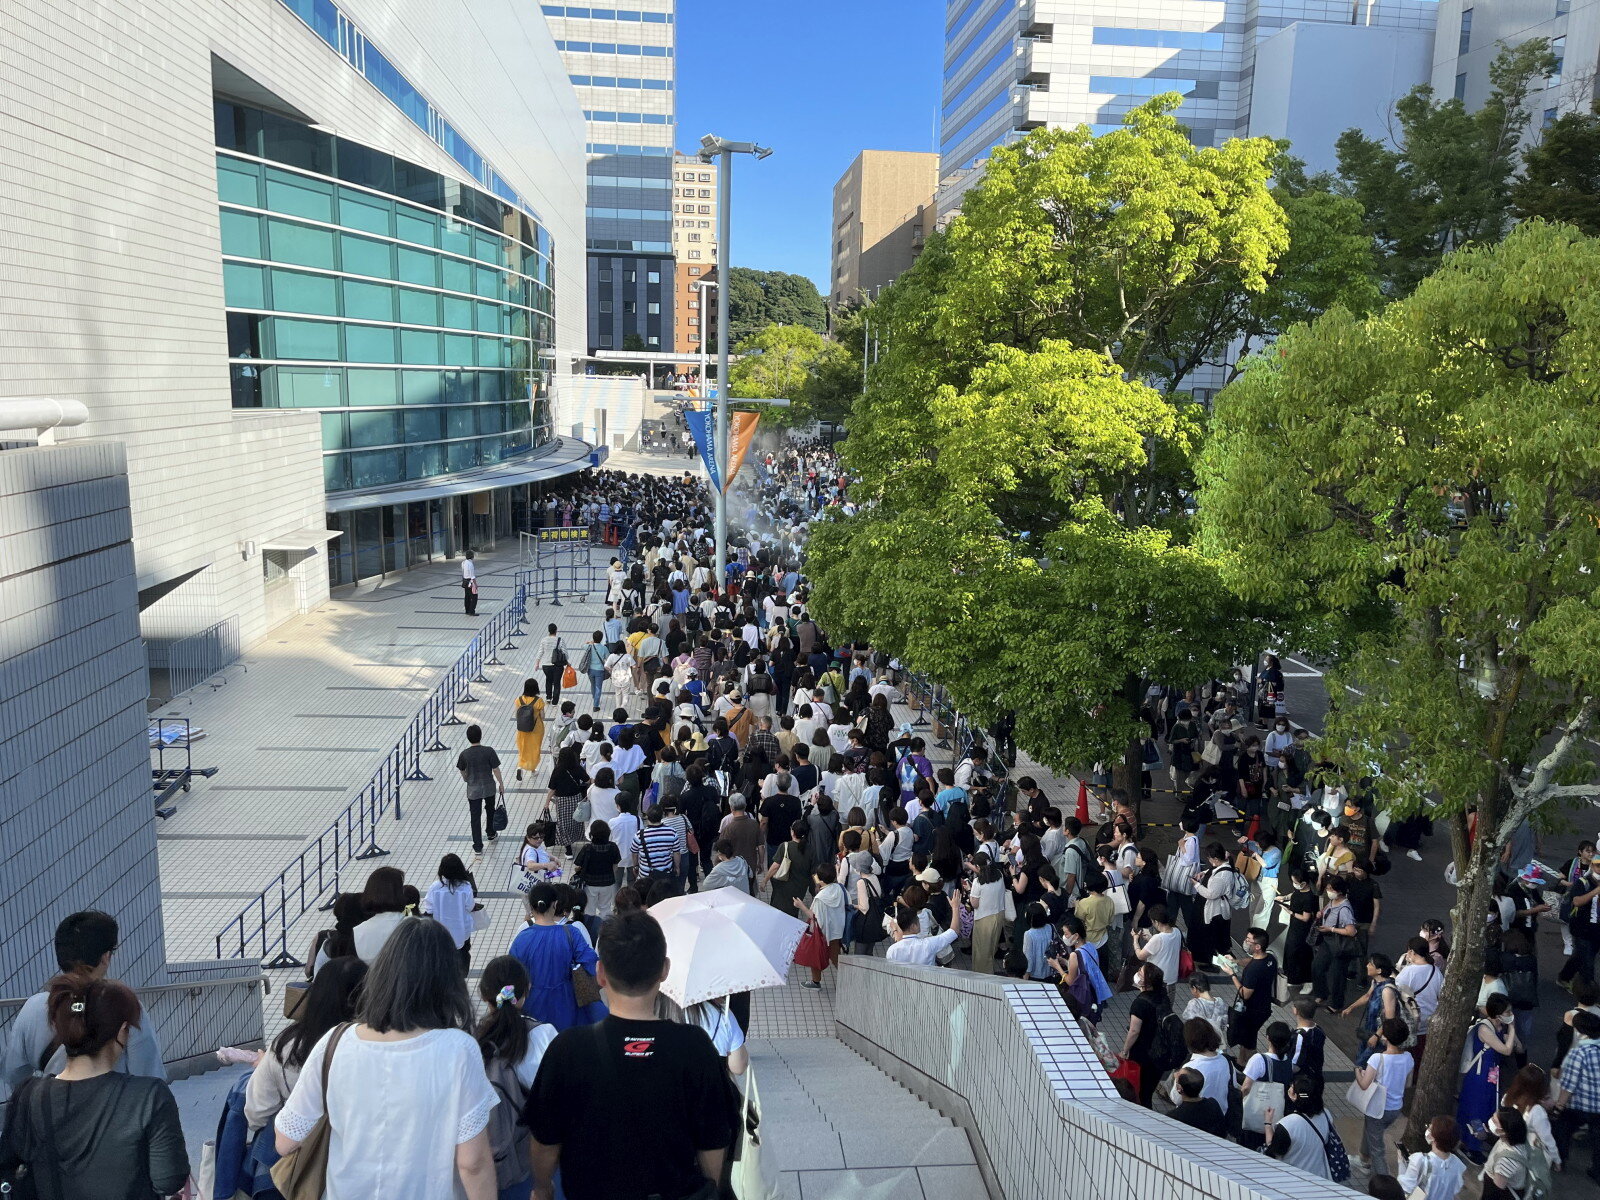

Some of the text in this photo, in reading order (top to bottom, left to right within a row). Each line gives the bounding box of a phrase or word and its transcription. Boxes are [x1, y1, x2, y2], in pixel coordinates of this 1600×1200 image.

[704, 413, 716, 475] YOKOHAMA ARENA
[541, 530, 588, 540] 手荷物検査
